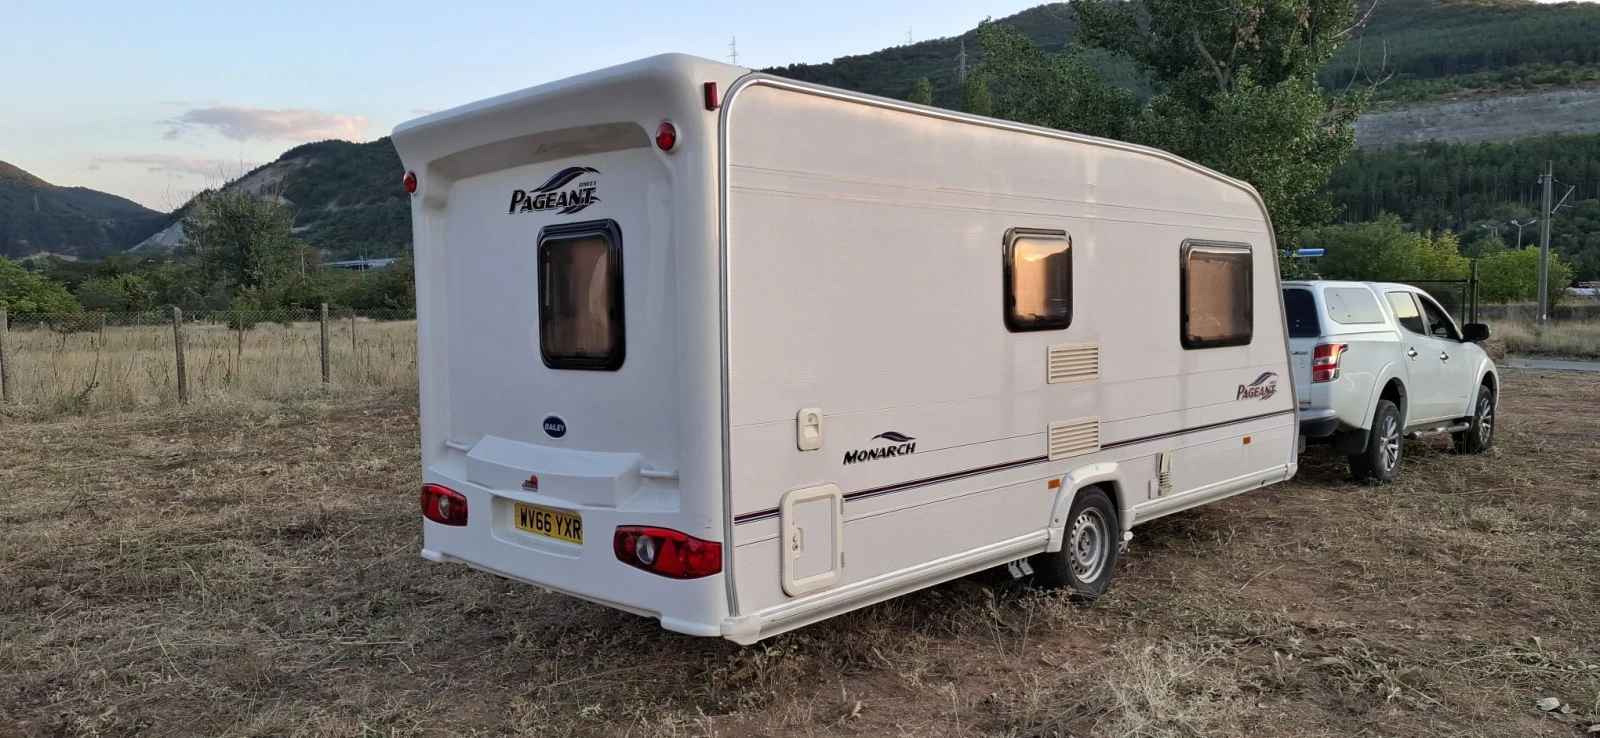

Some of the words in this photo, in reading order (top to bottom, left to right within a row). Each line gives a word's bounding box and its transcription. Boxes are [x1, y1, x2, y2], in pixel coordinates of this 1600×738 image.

[508, 187, 597, 214] PAGEANT
[1236, 384, 1277, 401] PAGEANT
[544, 423, 565, 432] BAILEY
[842, 442, 916, 465] MONARCH
[520, 507, 552, 532] WV66
[556, 514, 581, 540] YXR
